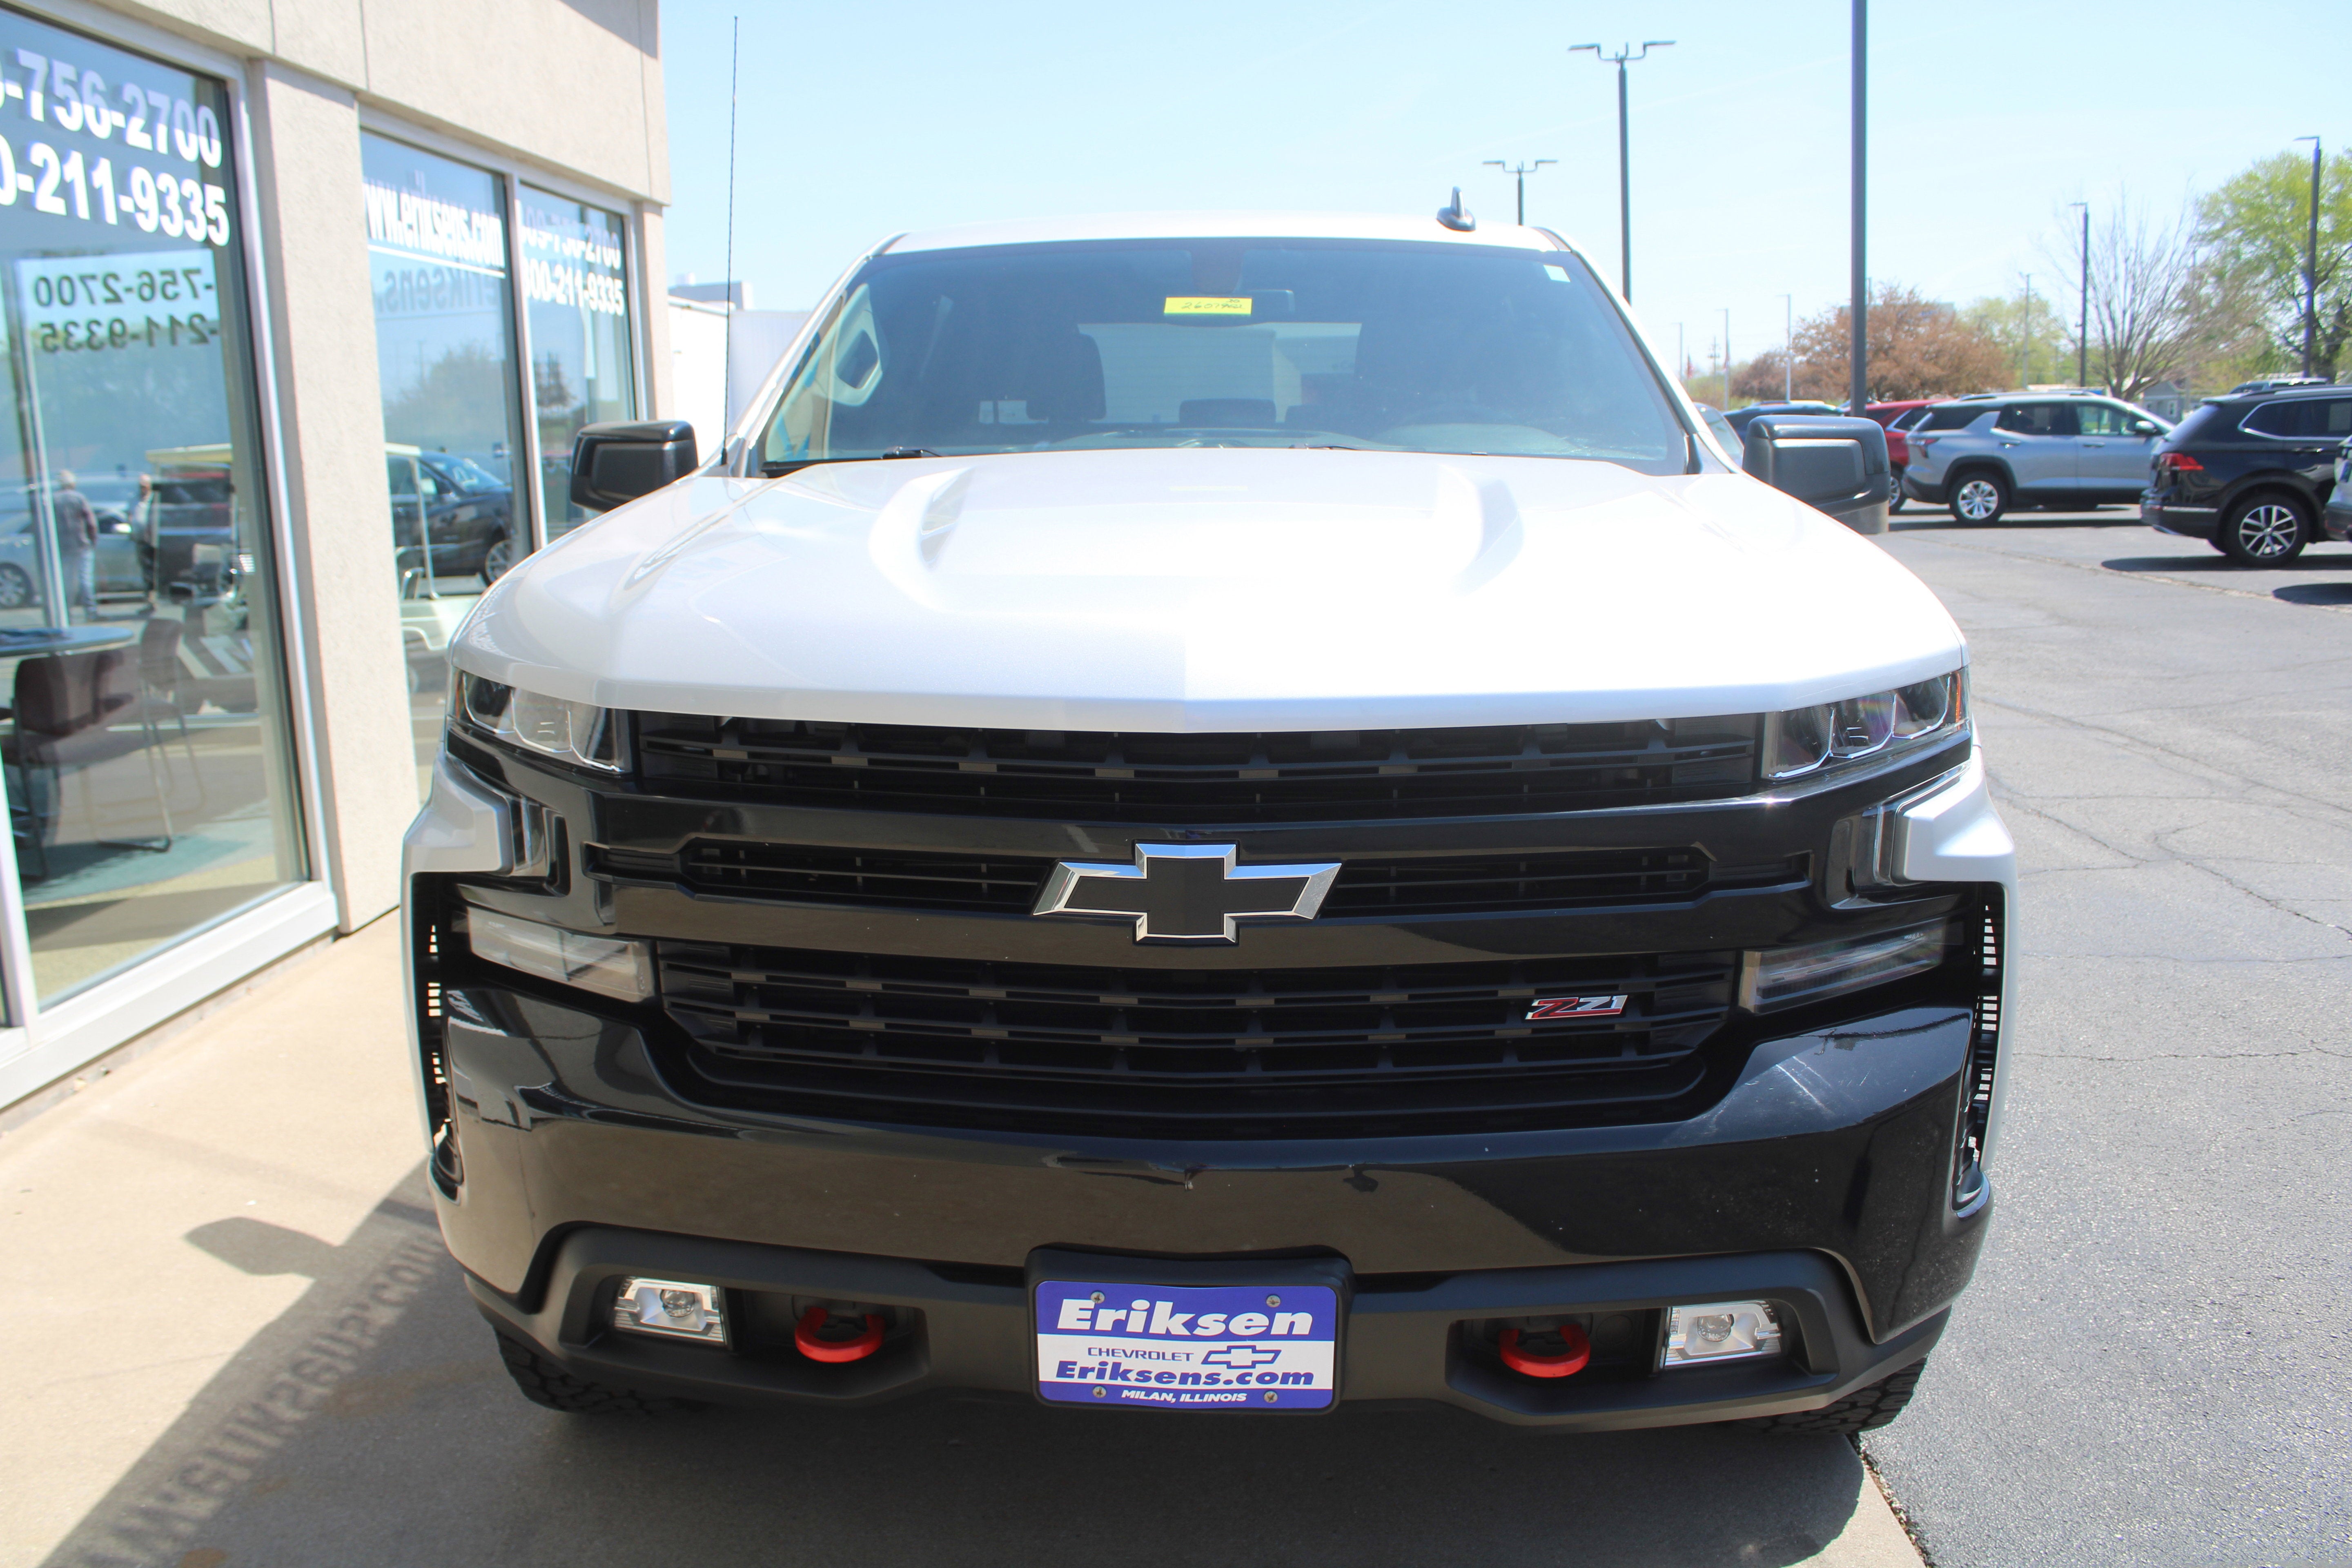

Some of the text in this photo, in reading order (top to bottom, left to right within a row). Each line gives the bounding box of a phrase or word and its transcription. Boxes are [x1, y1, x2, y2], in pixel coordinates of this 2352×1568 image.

[0, 47, 222, 168] -756-2700
[362, 169, 506, 269] ww.eriksens.com
[1525, 995, 1628, 1020] Z71
[1057, 1298, 1313, 1336] Eriksen
[1088, 1347, 1194, 1362] CHEVROLET
[1056, 1360, 1314, 1385] Eriksens.com
[1121, 1390, 1247, 1403] MILAN, ILLINOIS
